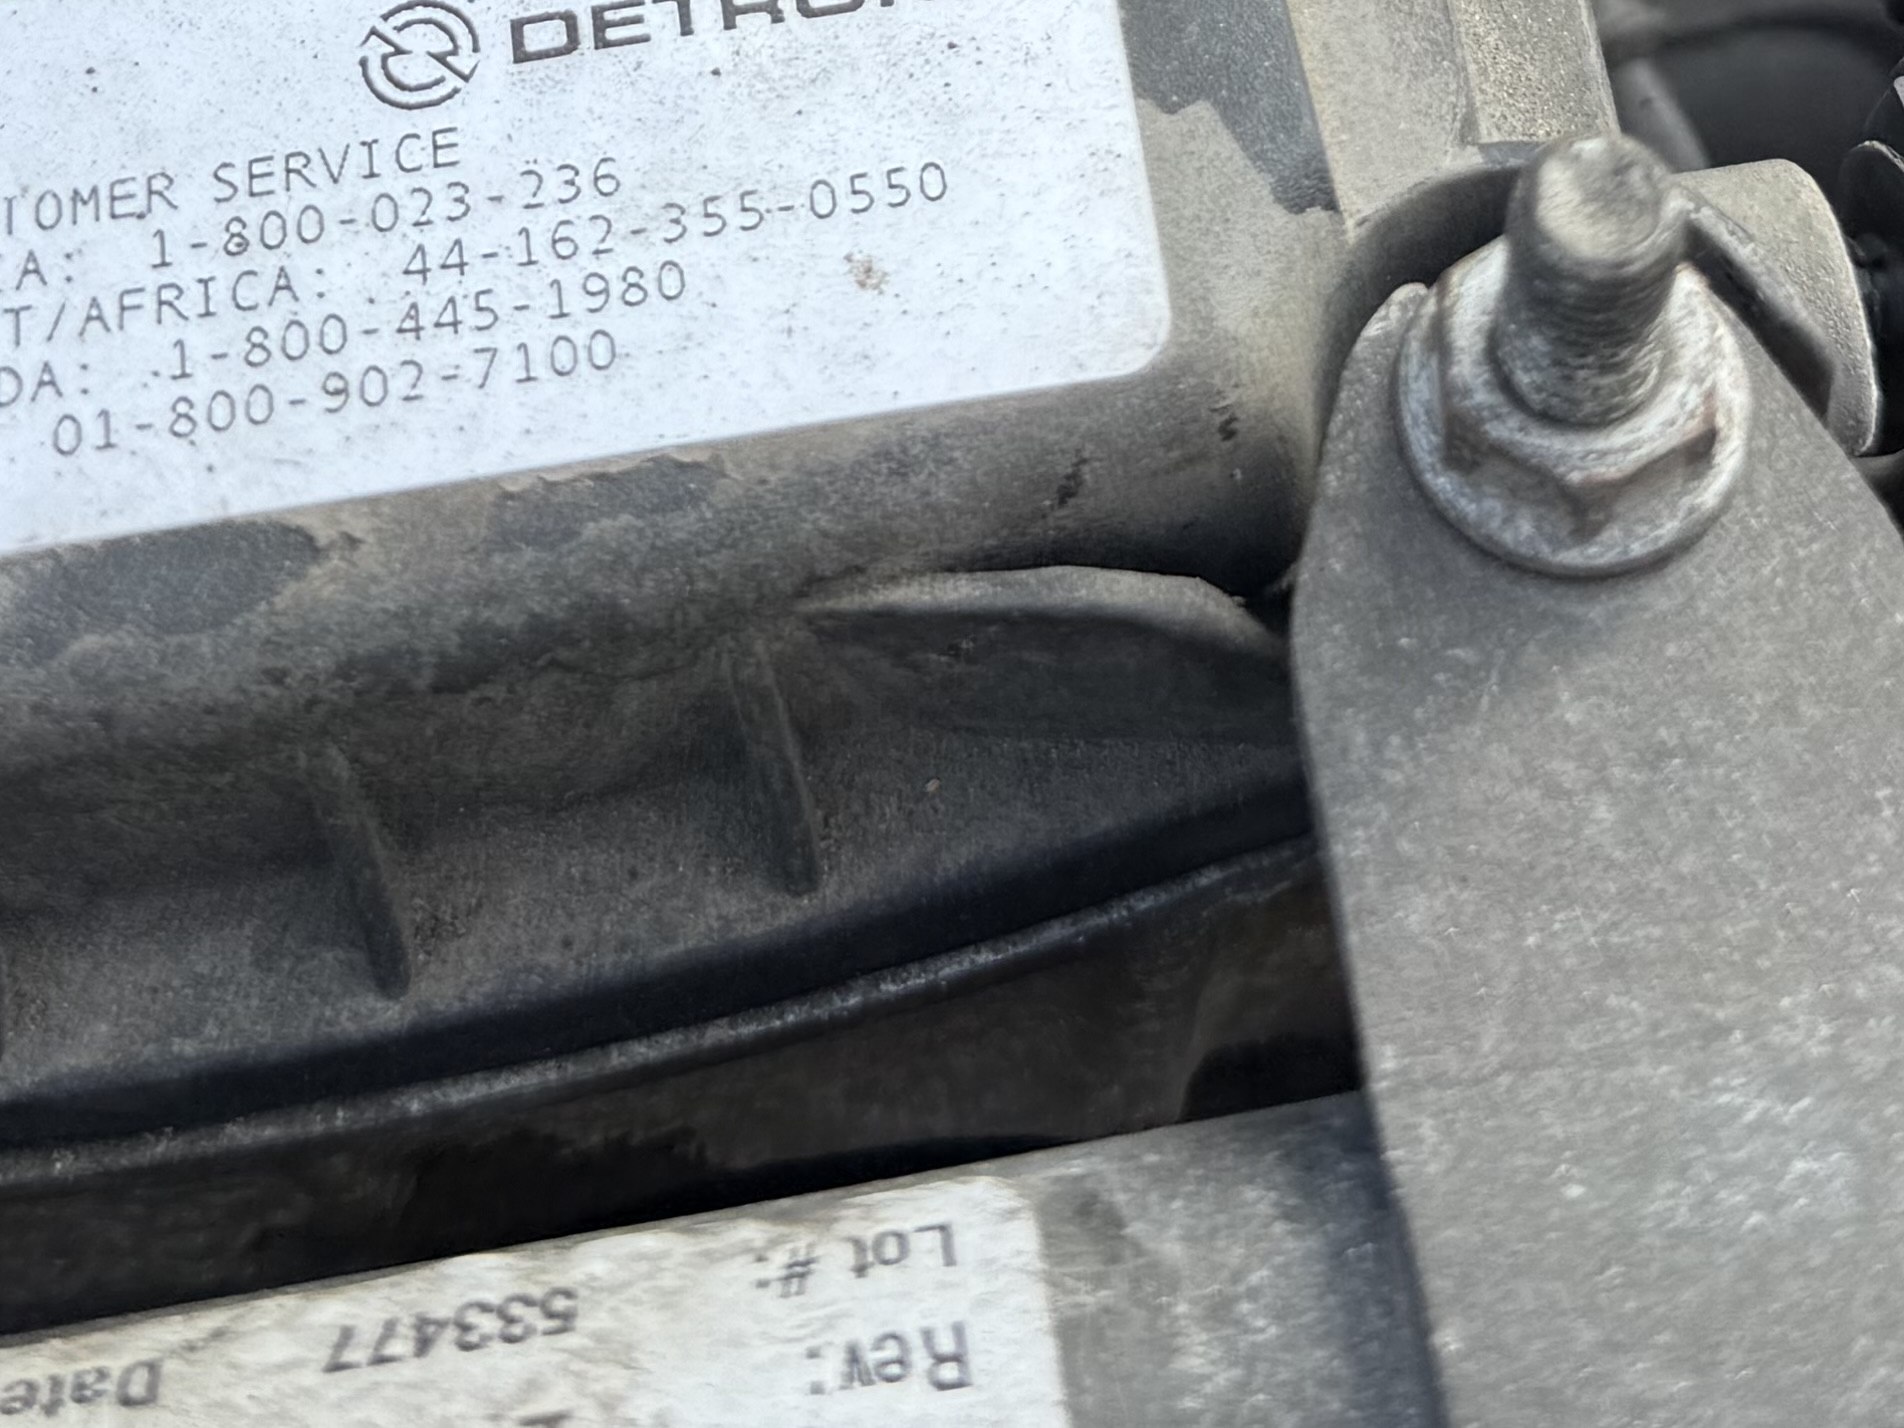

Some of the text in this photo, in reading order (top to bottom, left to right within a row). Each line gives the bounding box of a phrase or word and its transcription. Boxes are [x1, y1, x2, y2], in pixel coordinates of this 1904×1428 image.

[148, 155, 622, 270] 1-800-023-236
[211, 125, 462, 205] SERVICE
[399, 160, 949, 285] 44-162-355-0550
[168, 258, 687, 382] 1-800-445-1980
[51, 327, 618, 458] 01-800-902-7100
[846, 1221, 957, 1278] Lot
[321, 1287, 579, 1373] 533477
[805, 1320, 973, 1395] Rev:
